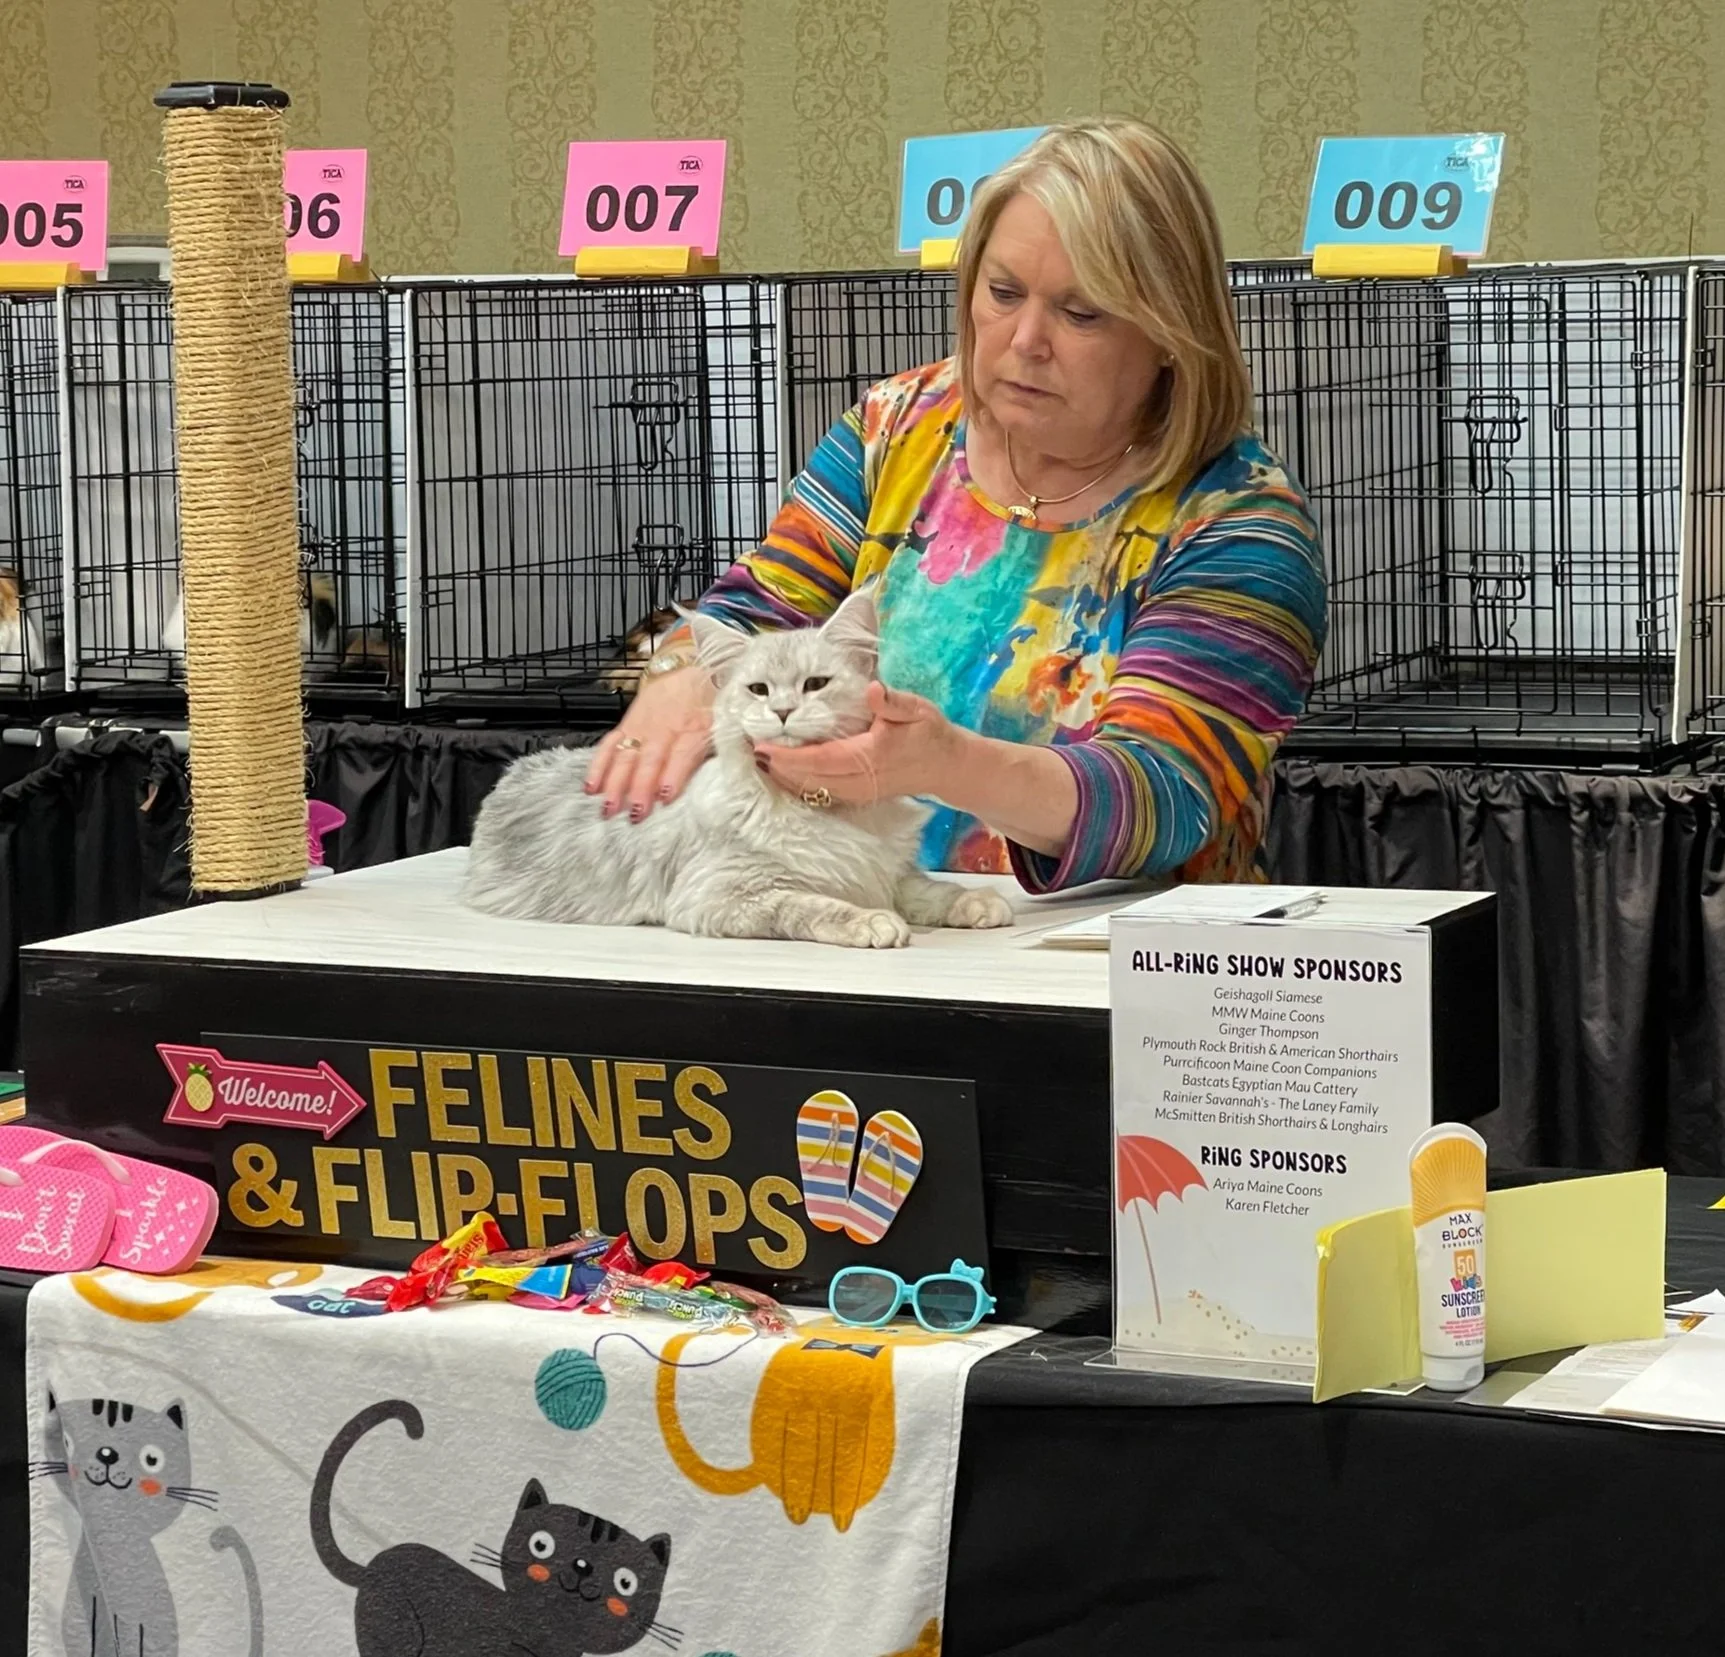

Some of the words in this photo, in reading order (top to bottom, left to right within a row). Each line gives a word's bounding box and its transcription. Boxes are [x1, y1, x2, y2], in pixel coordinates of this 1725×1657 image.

[322, 168, 343, 179] TICA
[679, 159, 701, 171] TICA
[64, 179, 85, 191] TICA
[585, 185, 700, 233] 007
[1334, 180, 1462, 231] 009
[0, 202, 84, 248] 05
[1227, 954, 1285, 978] SHOW
[1293, 957, 1403, 984] SPONSORS
[1213, 987, 1273, 1003] Geishagoll
[1276, 990, 1323, 1004] Siamese
[1211, 1006, 1248, 1019] MMW
[1250, 1008, 1286, 1022] Maine
[1289, 1010, 1325, 1023] Coons
[1218, 1023, 1257, 1039] Ginger
[1260, 1025, 1319, 1041] Thompson
[1142, 1036, 1197, 1051] Plymouth
[1199, 1040, 1226, 1053] Rock
[1229, 1042, 1266, 1055] British
[1268, 1044, 1277, 1055] &
[1280, 1044, 1336, 1059] American
[1338, 1047, 1399, 1063] Shorthairs
[1163, 1055, 1230, 1070] Purrcificoon
[1233, 1059, 1269, 1073] Maine
[1271, 1061, 1301, 1075] Coon
[1304, 1063, 1378, 1079] Companions
[218, 1076, 337, 1116] Welcome!
[1182, 1074, 1230, 1088] Bastcats
[1232, 1077, 1282, 1092] Egyptian
[1284, 1080, 1311, 1093] Mau
[1313, 1081, 1358, 1098] Cattery
[369, 1048, 731, 1160] FELINES
[1163, 1090, 1203, 1104] Rainier
[1205, 1093, 1269, 1108] Savannah's
[1279, 1097, 1300, 1111] The
[1302, 1100, 1337, 1117] Laney
[1339, 1101, 1379, 1117] Family
[1154, 1108, 1216, 1123] McSmitten
[1218, 1111, 1256, 1125] British
[1257, 1114, 1317, 1129] Shorthairs
[1319, 1118, 1328, 1130] &
[1331, 1119, 1389, 1135] Longhairs
[1249, 1148, 1347, 1175] SPONSORS
[227, 1143, 304, 1228] &
[1212, 1177, 1245, 1193] Ariya
[1247, 1180, 1284, 1194] Maine
[1286, 1182, 1323, 1197] Coons
[1225, 1198, 1260, 1212] Karen
[1263, 1201, 1310, 1216] Fletcher
[1449, 1212, 1472, 1226] MAX
[119, 1176, 169, 1264] Sparkle
[1442, 1226, 1482, 1241] BLOCK
[1456, 1255, 1474, 1276] 50
[1441, 1289, 1485, 1308] SUNSCREE
[1456, 1305, 1481, 1318] LOTION
